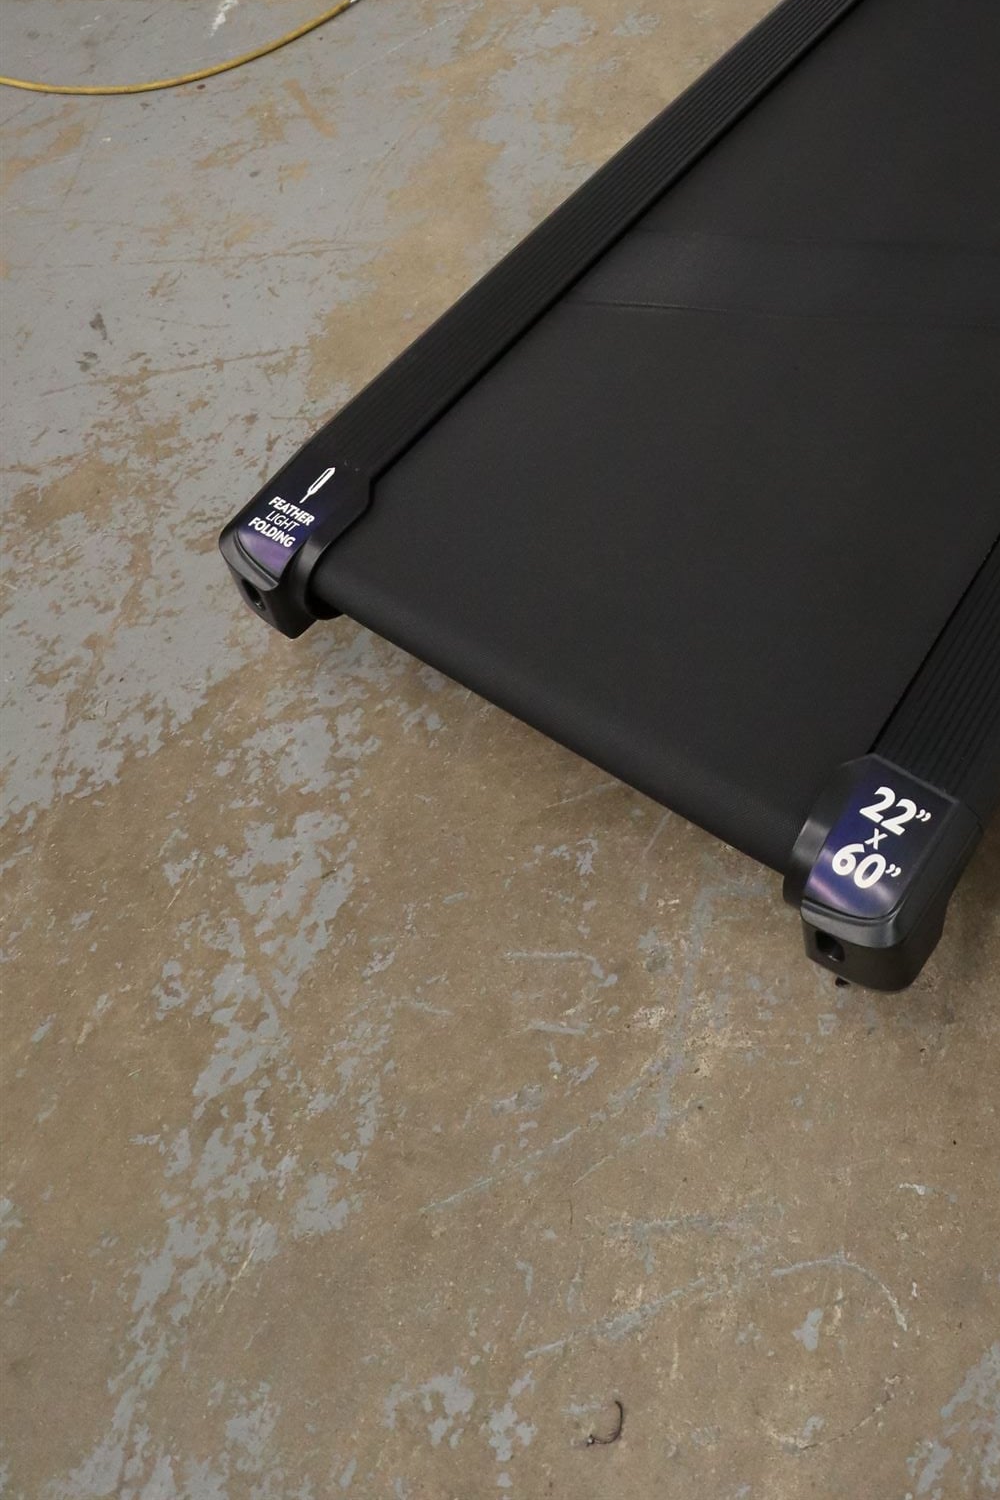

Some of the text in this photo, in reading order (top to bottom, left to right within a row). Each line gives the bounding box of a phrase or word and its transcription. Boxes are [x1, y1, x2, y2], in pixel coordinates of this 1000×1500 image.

[265, 510, 300, 532] LIGHT
[268, 496, 315, 526] FEATHER
[248, 516, 296, 548] FOLDING
